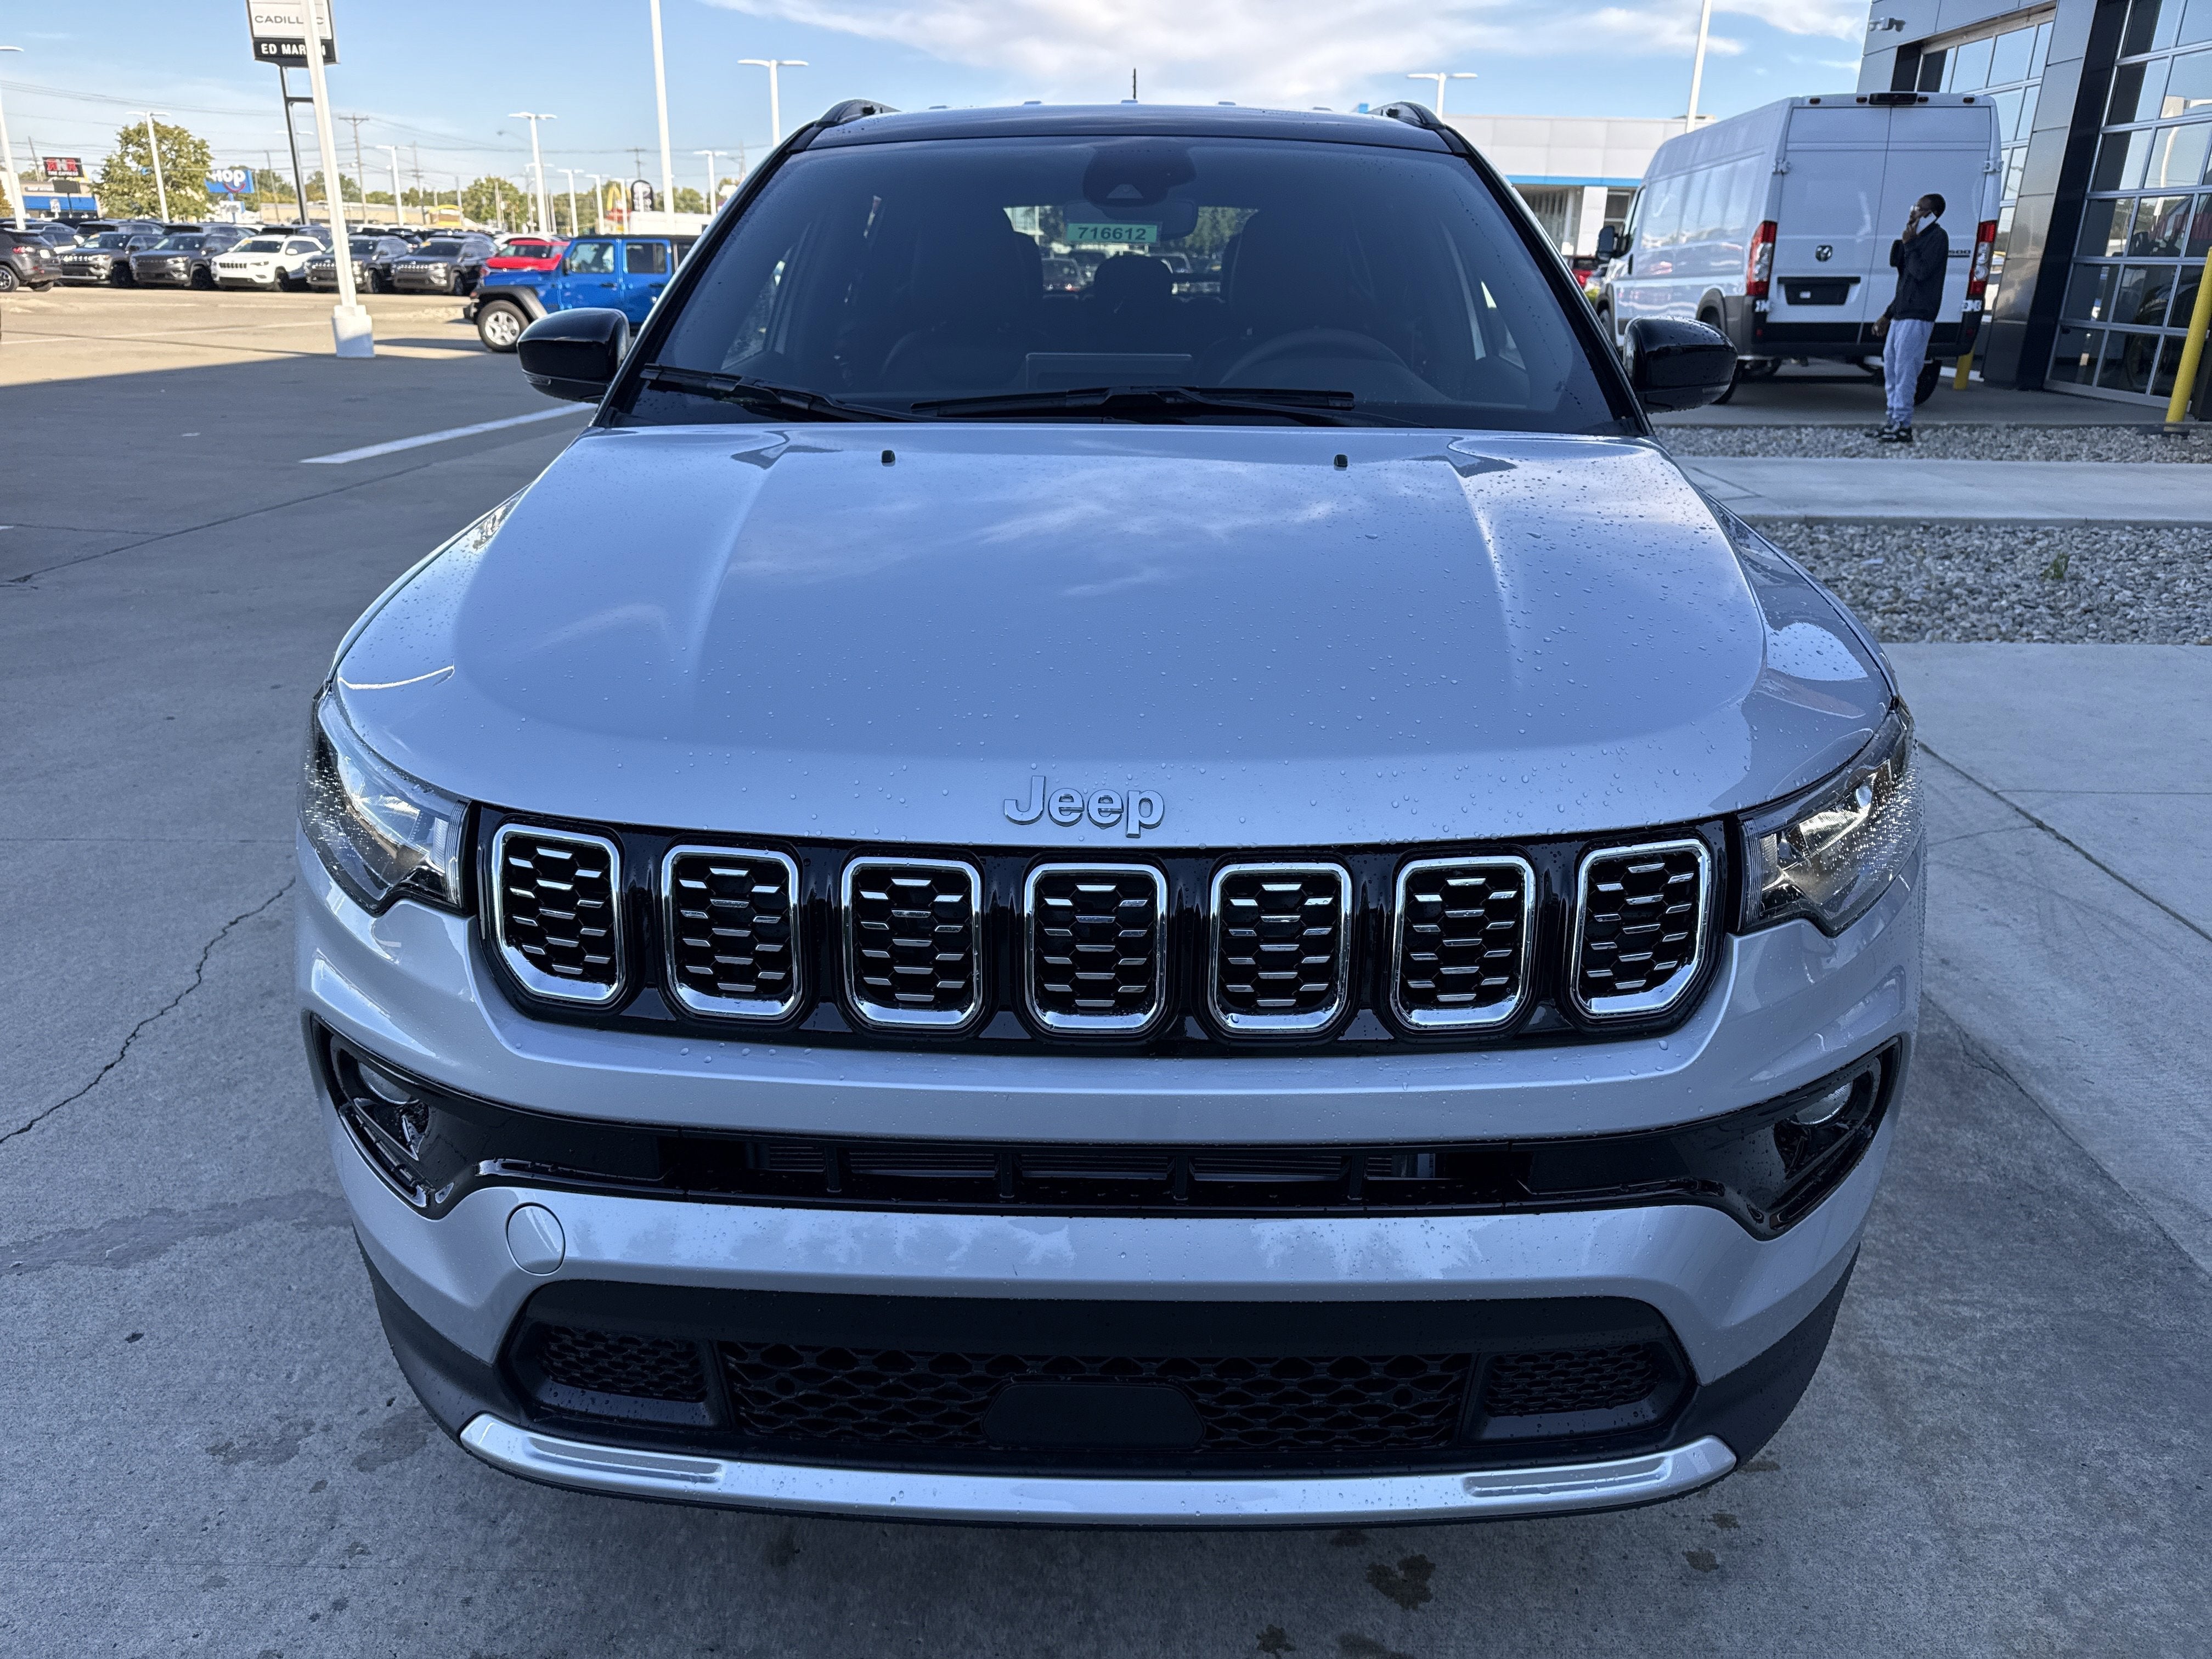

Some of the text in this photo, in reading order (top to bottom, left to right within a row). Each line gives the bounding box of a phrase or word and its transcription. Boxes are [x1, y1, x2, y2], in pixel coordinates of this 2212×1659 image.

[255, 15, 324, 25] CADILLC
[261, 43, 326, 56] ED MARN
[1078, 227, 1146, 240] 716612
[1004, 775, 1165, 838] Jeep
